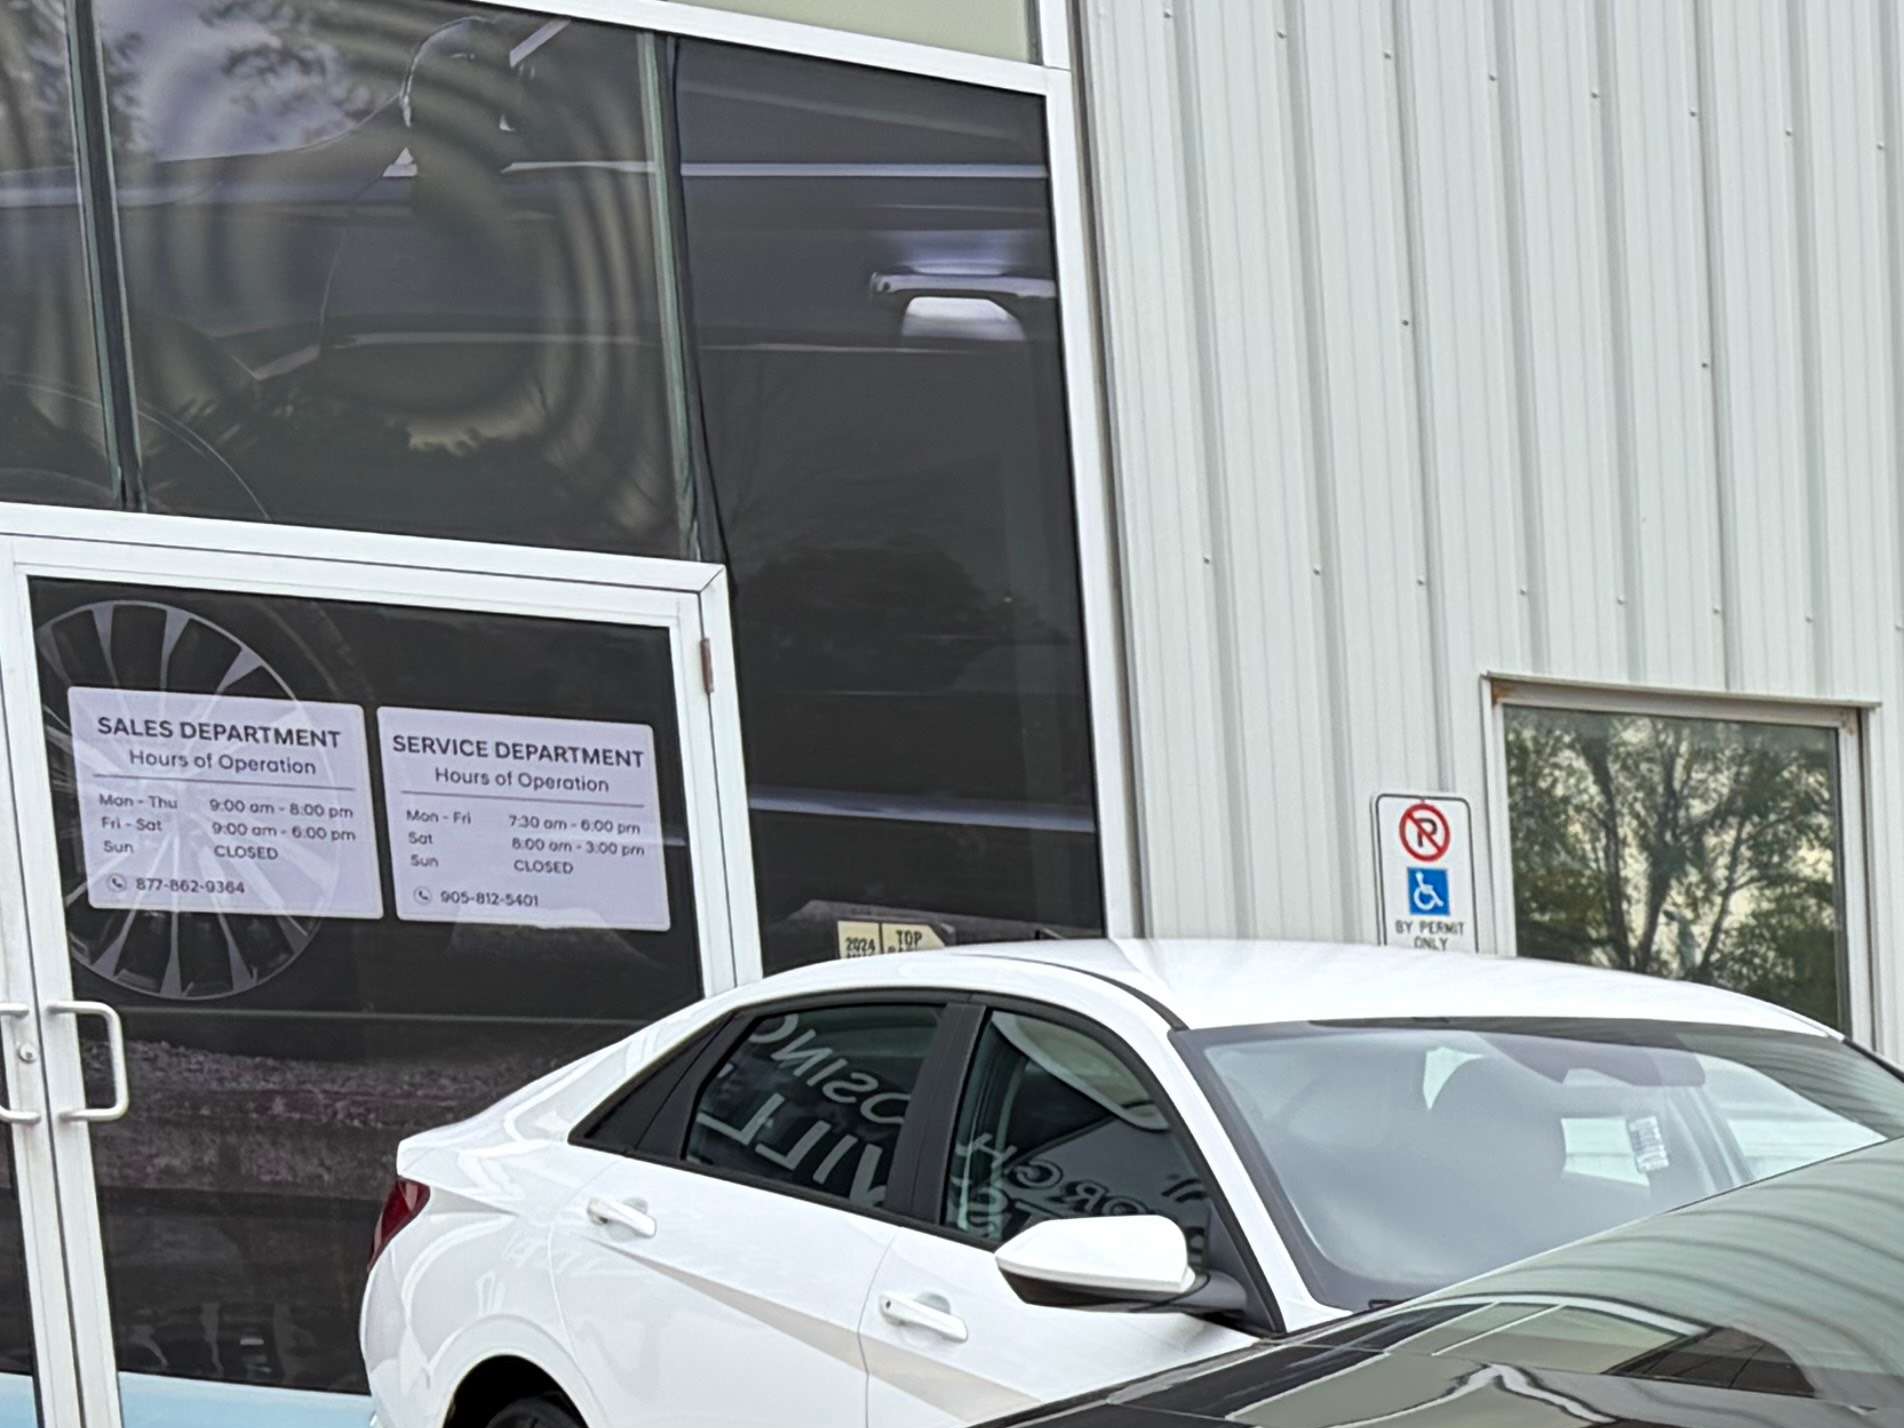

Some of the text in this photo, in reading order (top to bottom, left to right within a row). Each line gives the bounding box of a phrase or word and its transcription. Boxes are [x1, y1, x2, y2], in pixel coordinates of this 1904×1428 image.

[97, 716, 342, 749] SALES DEPARTMENT
[392, 735, 645, 768] SERVICE DEPARTMENT
[130, 750, 316, 775] Hours of Operation
[435, 768, 609, 792] Hours of Operation
[99, 794, 135, 808] Mon
[148, 795, 178, 809] Thu
[209, 798, 246, 813] 9:00
[250, 802, 275, 815] am
[289, 802, 325, 818] 8:00
[329, 806, 353, 821] pm
[101, 817, 122, 830] Fri
[136, 818, 162, 832] Sat
[406, 809, 439, 824] Mon
[453, 811, 471, 825] Fri
[508, 814, 540, 829] 7:30
[543, 819, 568, 832] am
[617, 822, 641, 836] pm
[211, 822, 248, 837] 9:00
[252, 826, 278, 838] am
[331, 830, 356, 845] pm
[408, 832, 433, 845] Sat
[103, 840, 134, 854] Sun
[213, 845, 279, 861] CLOSED
[549, 841, 572, 853] am
[621, 844, 645, 858] pm
[410, 854, 439, 868] Sun
[513, 860, 574, 875] CLOSED
[440, 890, 539, 907] 905-812-5401
[1395, 919, 1464, 936] BY PERMIT
[845, 936, 876, 953] 2024
[896, 929, 922, 948] TOP
[1414, 936, 1448, 950] ONLY
